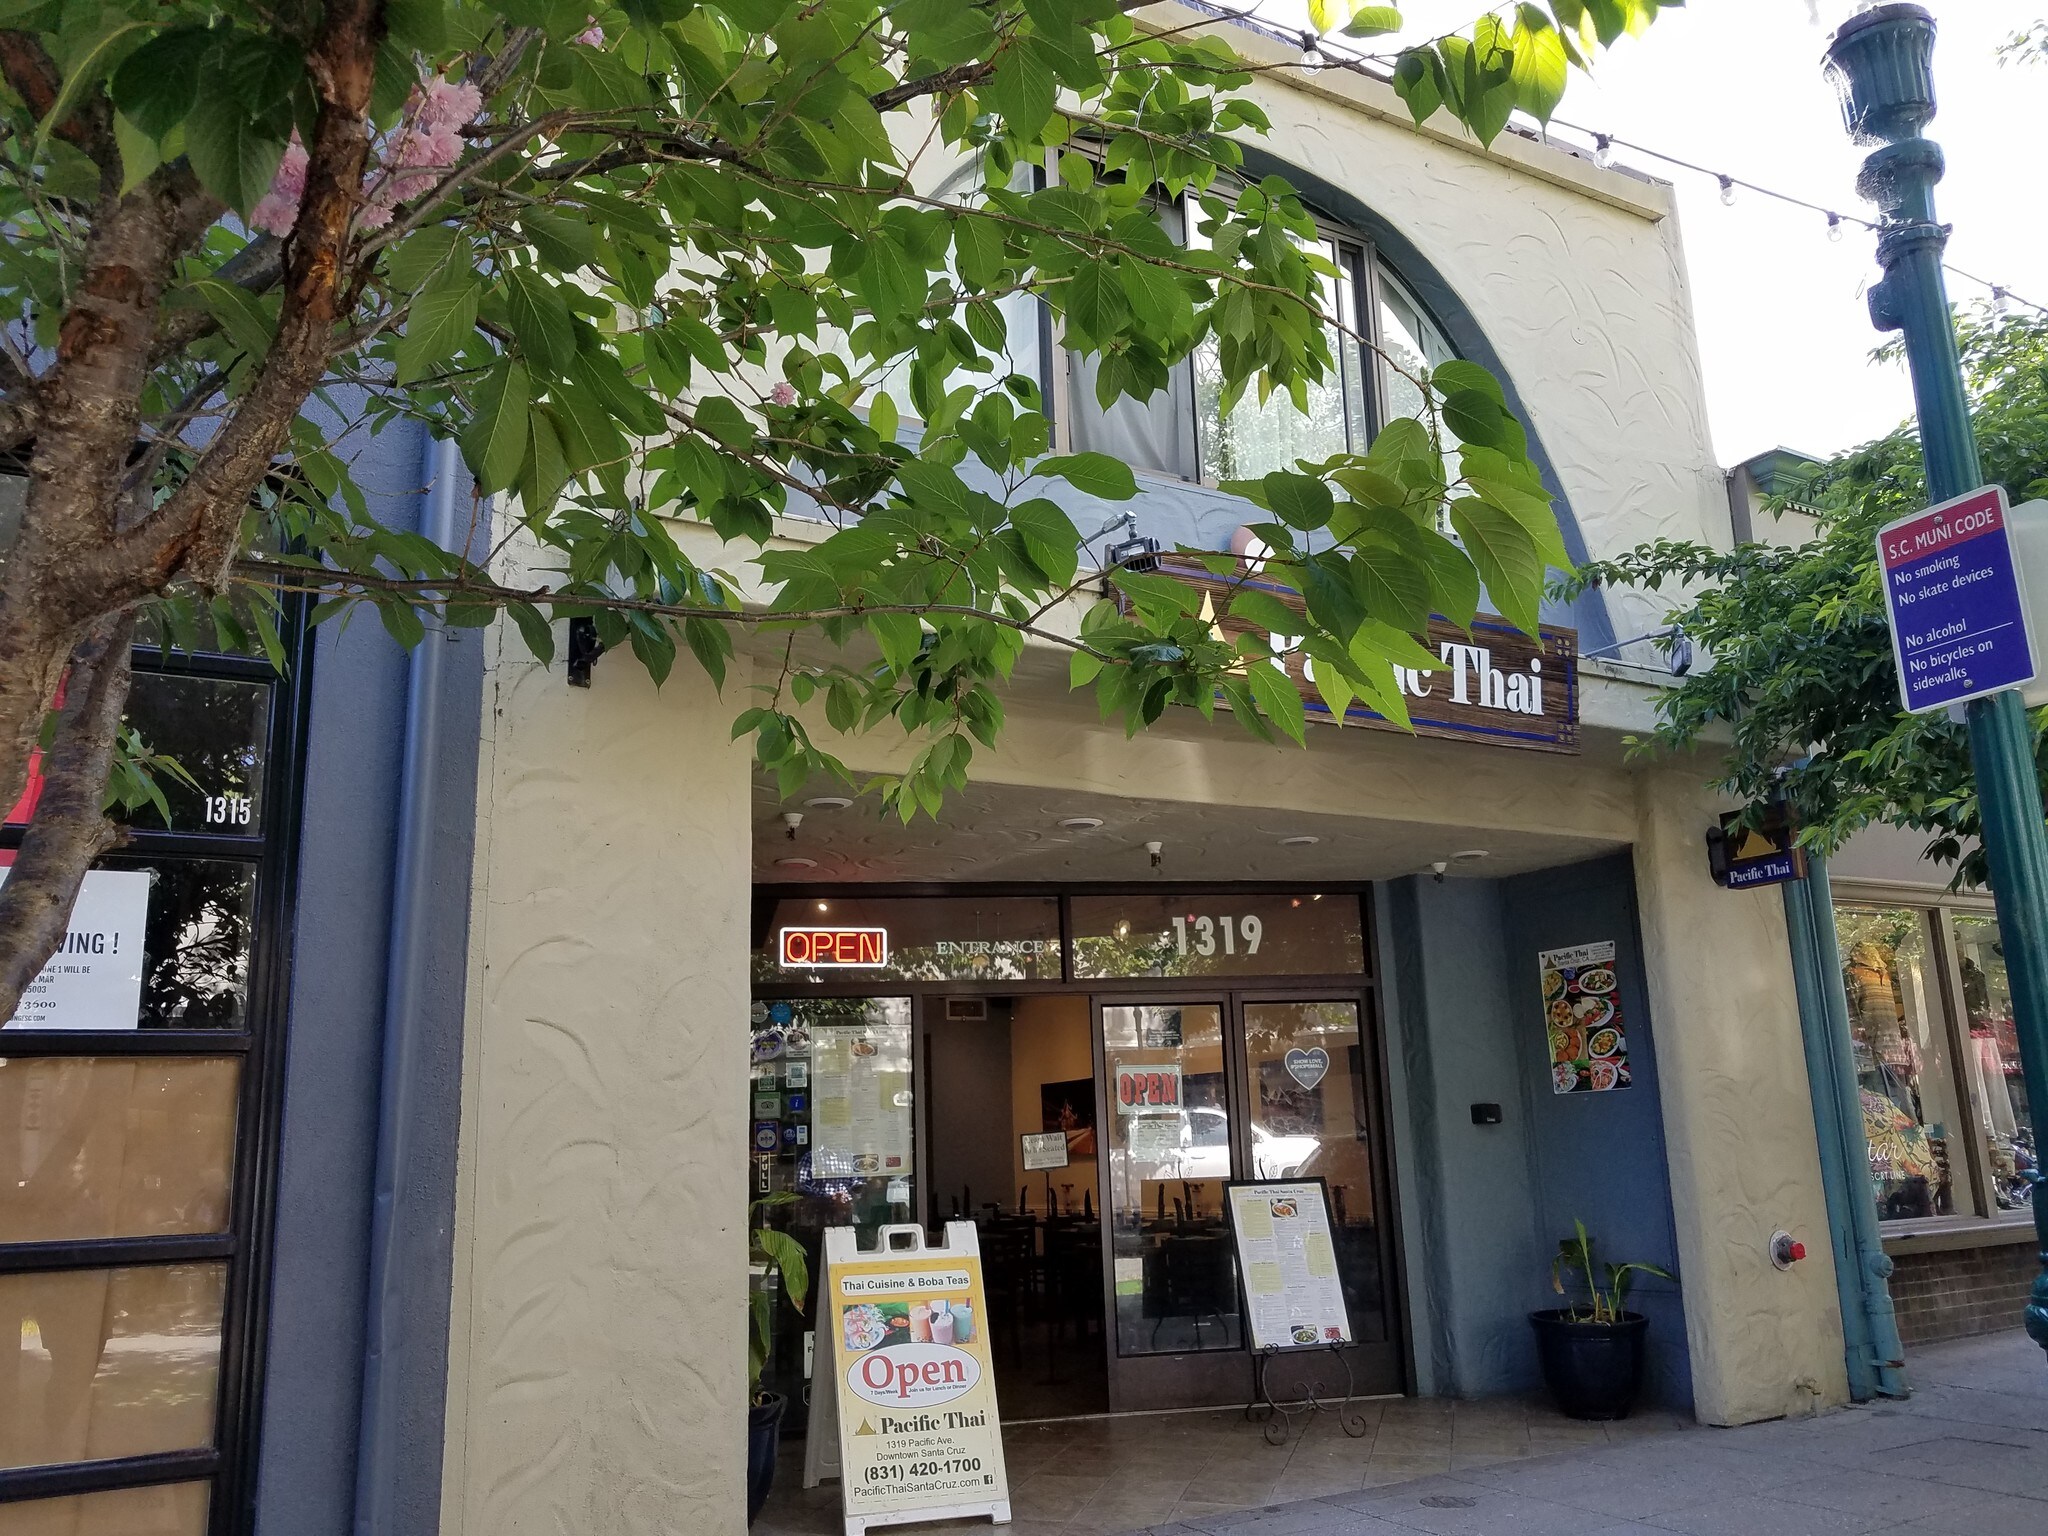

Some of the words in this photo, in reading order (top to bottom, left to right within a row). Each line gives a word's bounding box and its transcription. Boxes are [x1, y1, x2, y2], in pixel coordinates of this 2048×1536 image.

[1888, 539, 1913, 560] S.C.
[1915, 523, 1952, 550] MUNI
[1954, 507, 1995, 535] CODE
[1894, 572, 1913, 586] No
[1914, 555, 1961, 579] smoking
[1898, 593, 1916, 607] No
[1918, 581, 1949, 600] skate
[1951, 565, 1994, 588] devices
[1905, 635, 1923, 649] No
[1926, 618, 1967, 643] alcohol
[1909, 659, 1928, 673] No
[1930, 643, 1975, 667] bicycles
[1978, 640, 1994, 652] on
[1440, 641, 1546, 717] Thai
[1912, 667, 1968, 692] sidewalks
[205, 796, 251, 826] 1315
[1729, 866, 1764, 884] Pacific
[1764, 861, 1790, 877] Thai
[786, 932, 882, 963] OPEN
[936, 940, 1045, 955] ENTRANCE
[1172, 914, 1263, 956] 1319
[38, 975, 55, 984] MAR
[63, 965, 80, 974] WILL
[82, 965, 91, 974] BE
[24, 985, 47, 994] 5003
[1119, 1072, 1179, 1107] OPEN
[843, 1281, 865, 1291] Thai
[867, 1280, 905, 1290] Cuisine
[907, 1278, 916, 1287] &
[918, 1277, 944, 1287] Boba
[946, 1275, 969, 1286] Teas
[862, 1355, 967, 1399] Open
[880, 1414, 941, 1435] Pacific
[943, 1409, 986, 1430] Thai
[876, 1451, 919, 1462] Downtown
[921, 1448, 945, 1457] Santa
[946, 1446, 966, 1455] Cruz
[886, 1439, 907, 1449] 1319
[908, 1437, 936, 1448] Pacific
[936, 1436, 955, 1445] Ave.
[864, 1464, 905, 1484] (831)
[909, 1457, 981, 1477] 420-1700
[853, 1477, 980, 1497] PacificThaiSantaCruz.com
